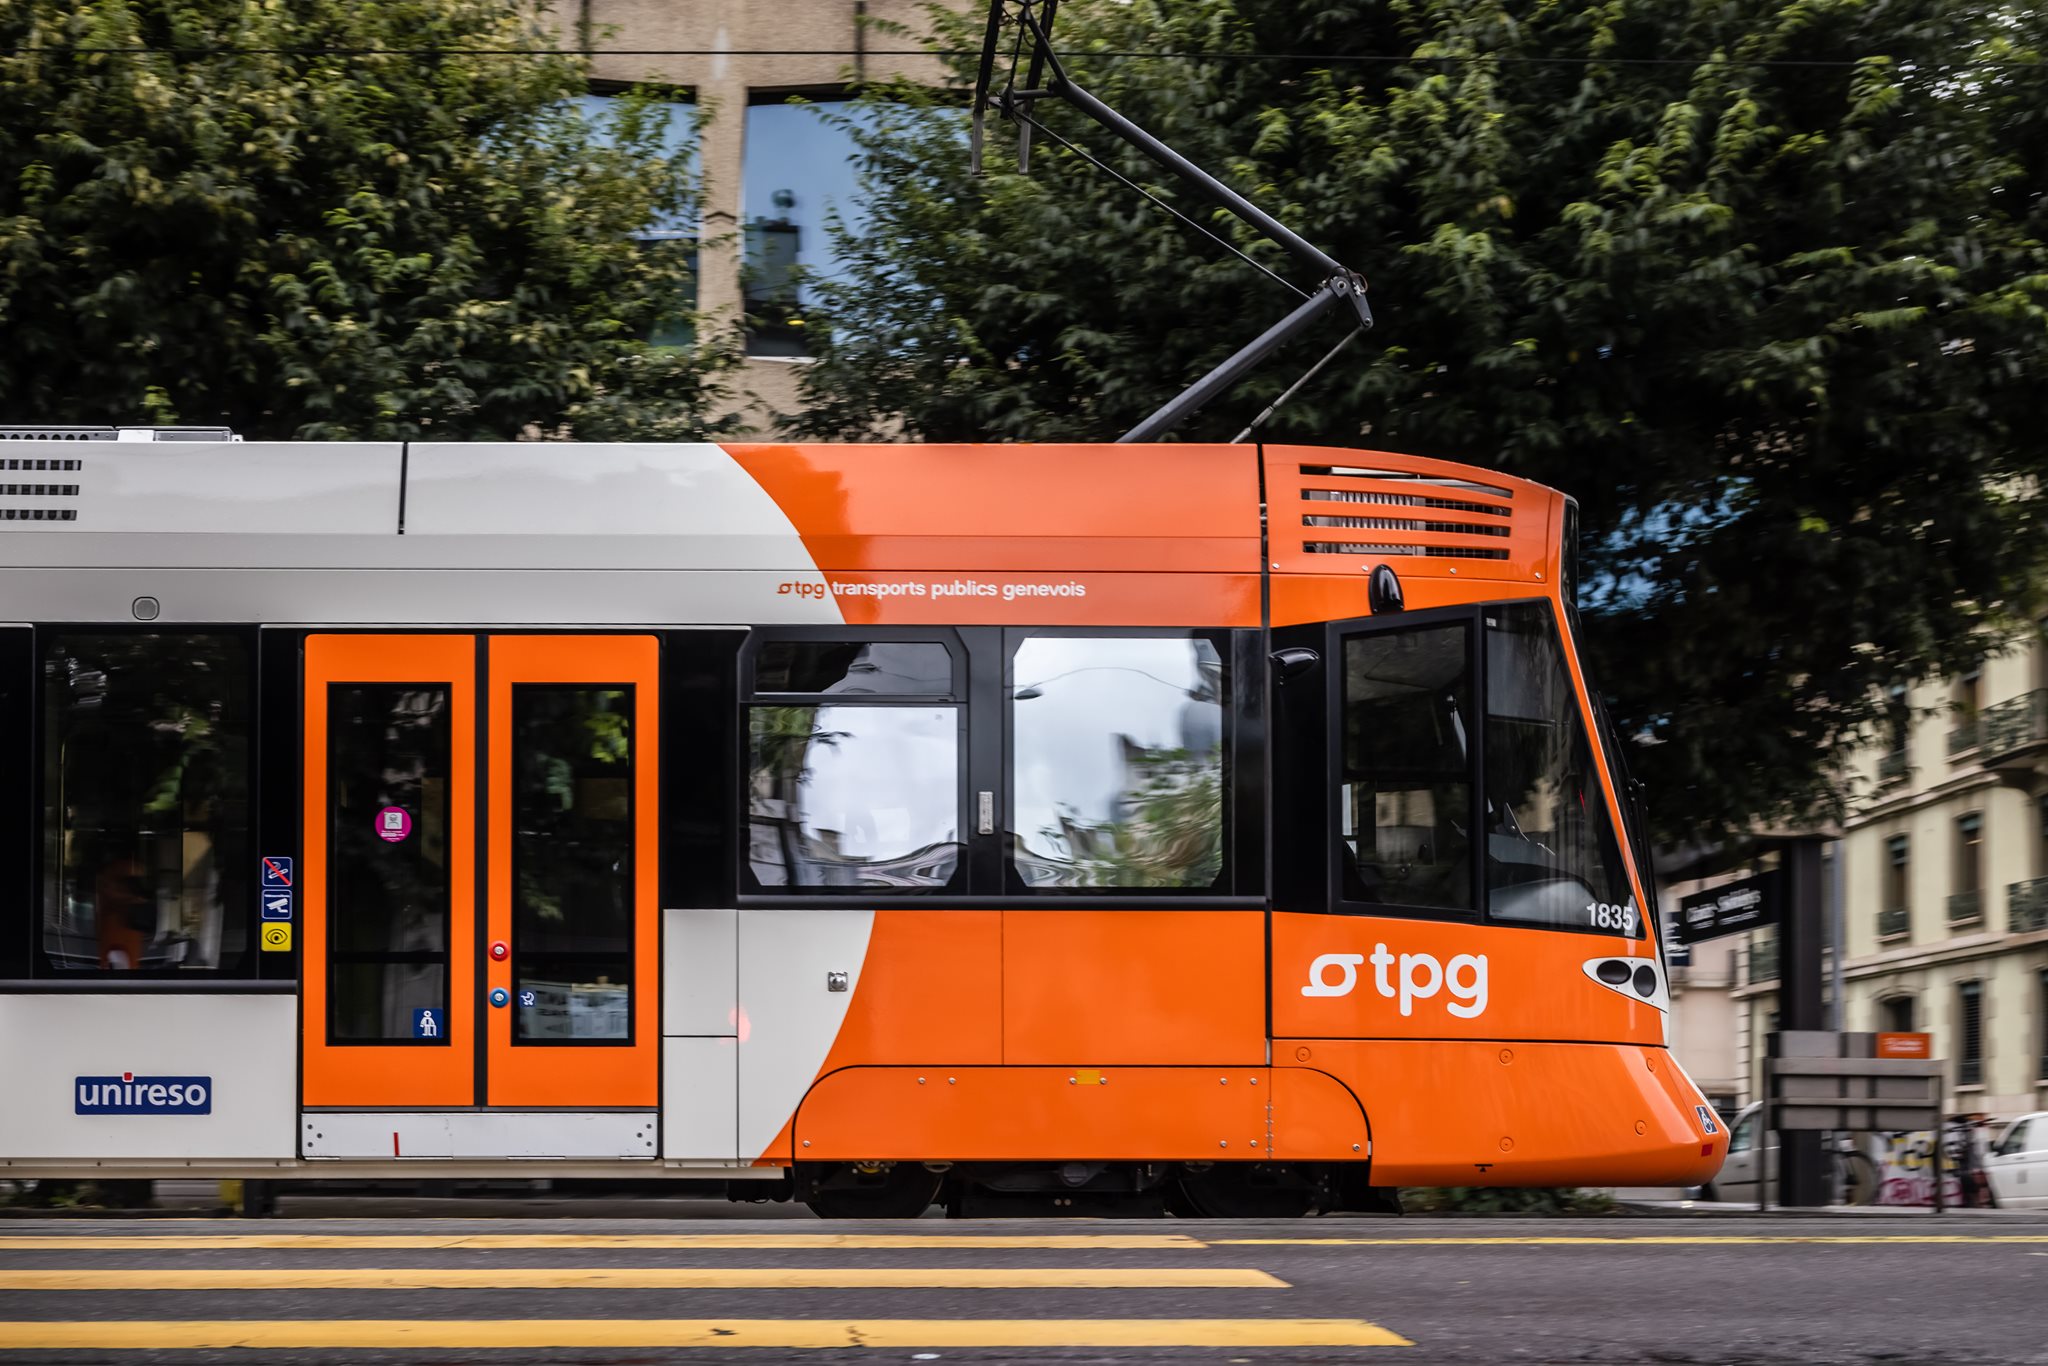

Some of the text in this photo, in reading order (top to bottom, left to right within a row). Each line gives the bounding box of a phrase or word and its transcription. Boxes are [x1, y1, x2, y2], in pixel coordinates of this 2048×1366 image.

[832, 580, 926, 599] transports
[931, 580, 998, 600] publics
[1002, 581, 1086, 601] genevois
[1586, 902, 1634, 931] 1835
[79, 1072, 207, 1106] unireso
